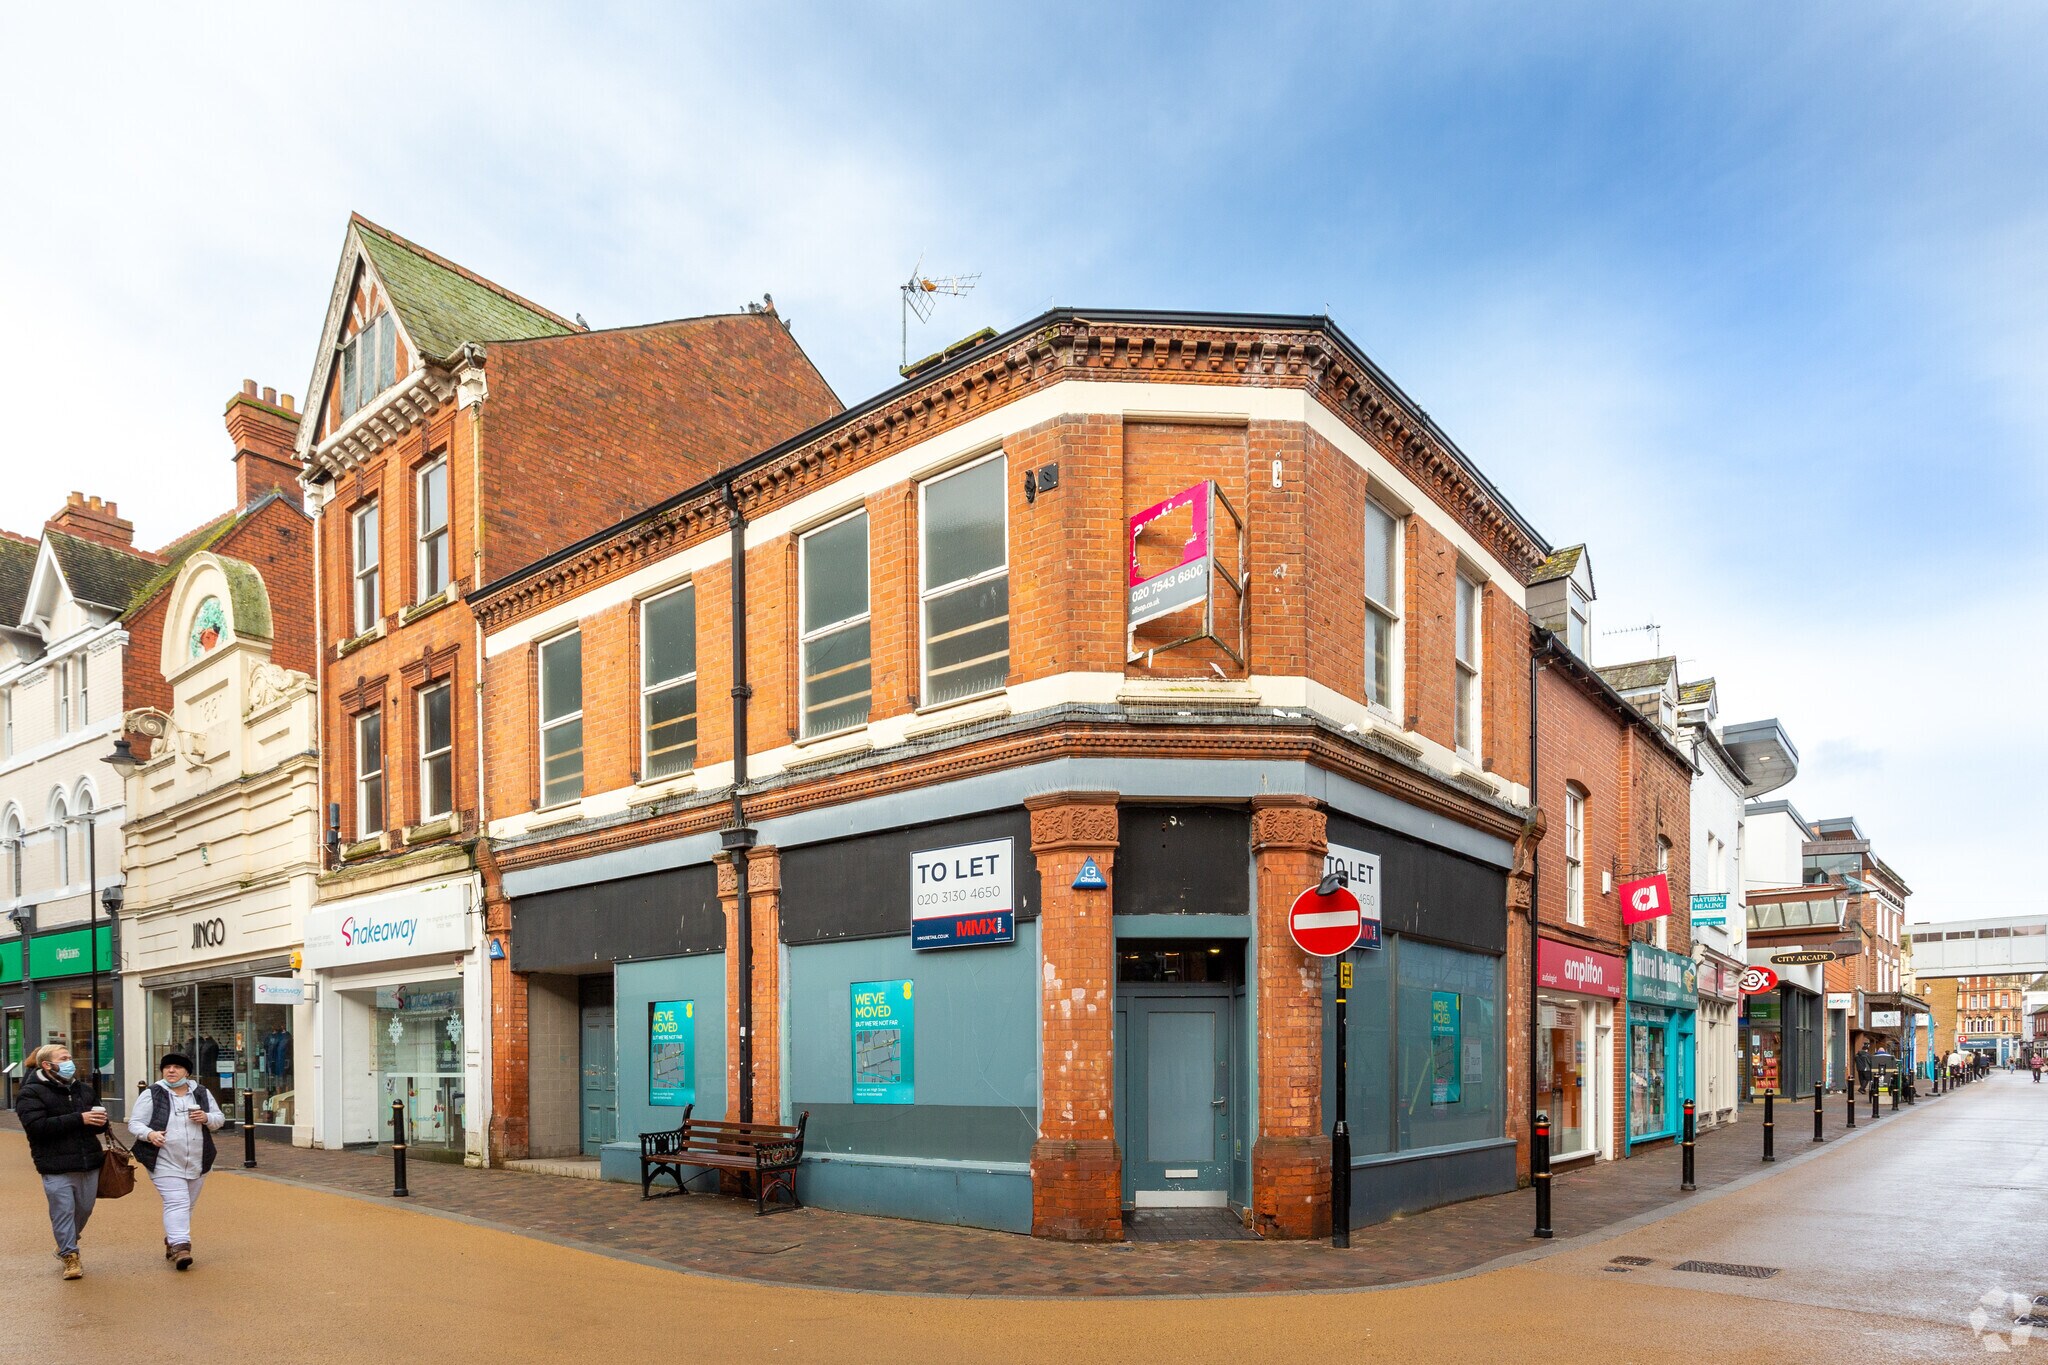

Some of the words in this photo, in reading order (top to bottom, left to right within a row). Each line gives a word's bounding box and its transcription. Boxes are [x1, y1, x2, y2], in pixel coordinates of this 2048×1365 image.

[1132, 587, 1149, 602] 020
[1152, 576, 1175, 594] 7543
[1177, 564, 1203, 583] 6800
[1131, 598, 1160, 615] allsop.co.uk
[917, 862, 947, 884] TO
[955, 854, 1000, 879] LET
[1350, 861, 1374, 884] LET
[917, 893, 939, 906] 020
[941, 889, 967, 903] 3130
[970, 885, 1001, 900] 4650
[1358, 893, 1375, 906] 4650
[191, 917, 226, 949] JINGO
[341, 916, 418, 947] Shakeaway
[956, 917, 998, 938] MMX
[56, 947, 80, 963] Opticians
[1796, 954, 1828, 962] ARCADE
[1564, 955, 1603, 989] amplifon
[1633, 948, 1657, 979] Natural
[1658, 955, 1682, 989] Healing
[258, 984, 302, 996] Shakeaway
[855, 992, 885, 1006] WE'VE
[855, 1005, 891, 1018] MOVED
